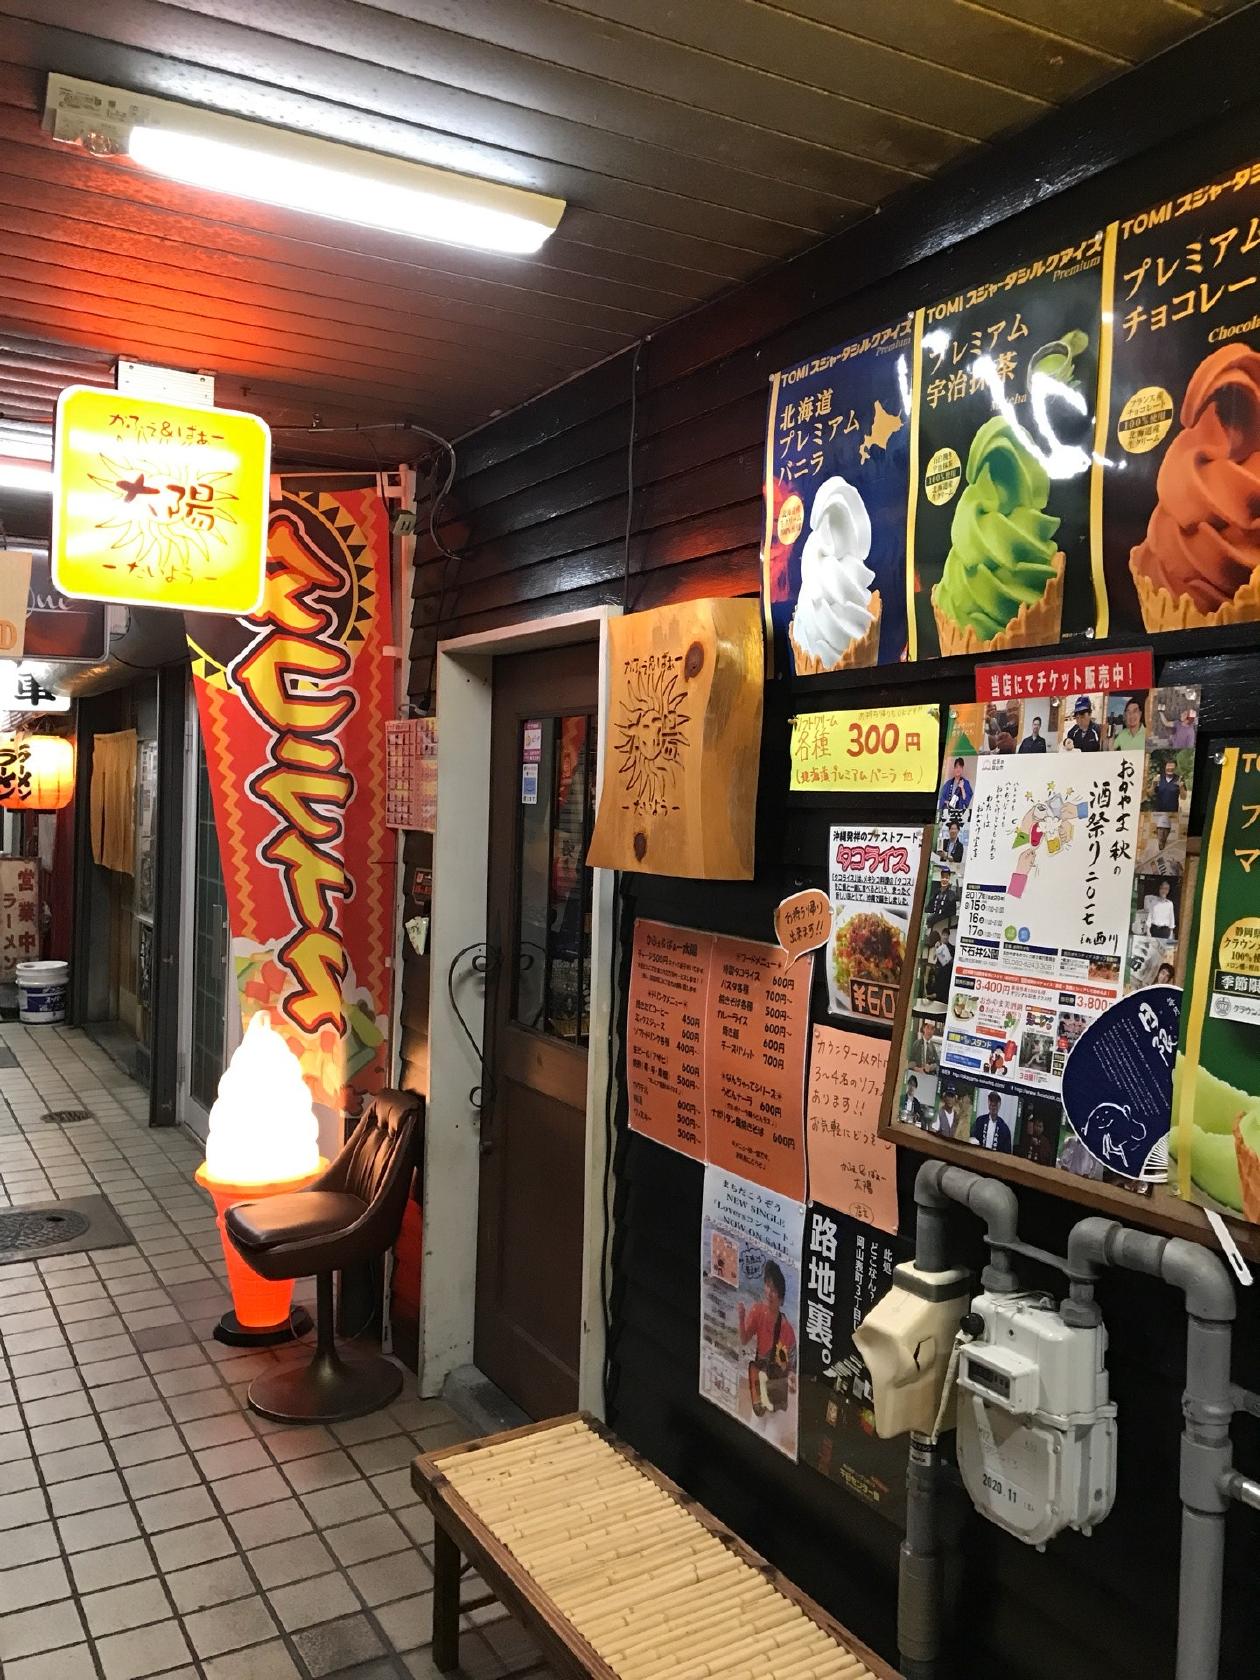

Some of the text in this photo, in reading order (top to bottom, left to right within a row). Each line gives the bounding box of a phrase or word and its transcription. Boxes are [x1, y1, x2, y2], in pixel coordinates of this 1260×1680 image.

[1121, 202, 1172, 239] TOMI
[1053, 256, 1100, 282] Premium
[927, 299, 964, 324] TOMI
[782, 366, 809, 388] TOMI
[780, 388, 833, 431] 北海道
[780, 410, 860, 459] プレミアム
[778, 451, 824, 487] バニラ
[795, 722, 921, 761] 各種 300円
[836, 844, 911, 875] タコライス
[18, 868, 36, 954] 営業中
[3, 892, 17, 970] ラーメン
[960, 944, 999, 960] 下石井公園
[772, 976, 795, 991] 600円
[717, 1010, 748, 1026] カレーライス
[762, 1053, 785, 1070] 700円
[763, 1039, 785, 1055] 600円
[760, 1101, 782, 1118] 600円
[772, 1132, 796, 1150] 600円
[723, 1179, 781, 1213] まちだこうぞう
[726, 1192, 786, 1228] NEW SINGLE
[723, 1214, 789, 1256] NOW ON SALE
